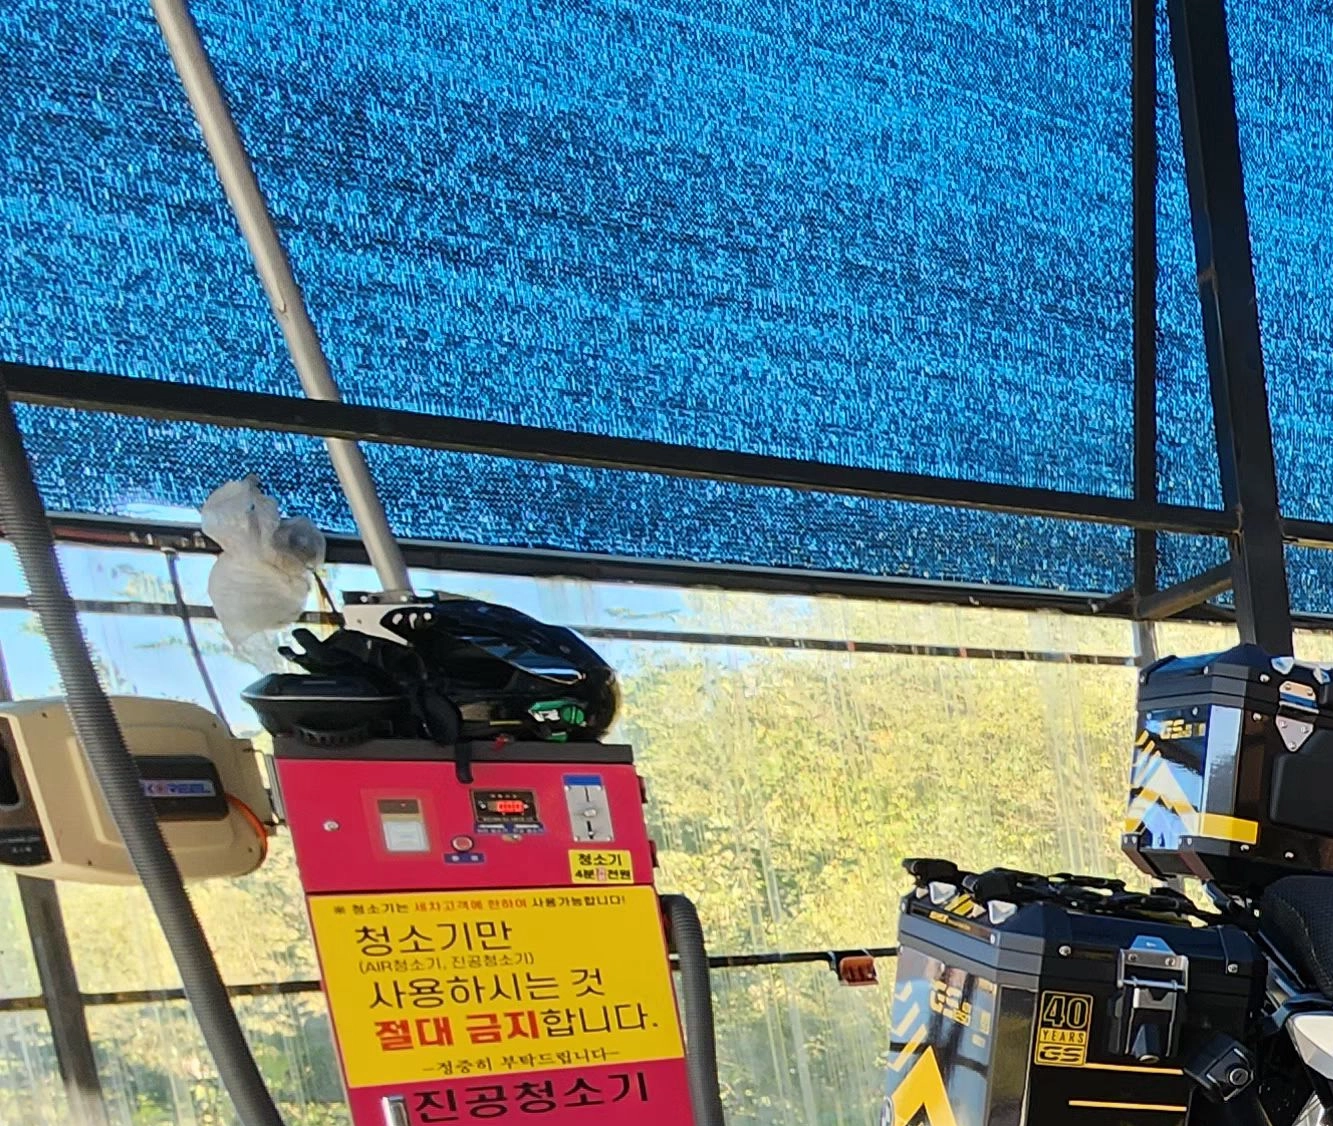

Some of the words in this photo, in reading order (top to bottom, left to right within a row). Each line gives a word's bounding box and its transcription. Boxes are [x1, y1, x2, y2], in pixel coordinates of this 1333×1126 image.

[578, 854, 622, 866] 청소기
[352, 903, 409, 914] 청소기는
[488, 899, 527, 909] 한하여
[531, 895, 626, 908] 사용가능합니다!
[355, 920, 512, 957] 청소기만
[359, 957, 447, 974] (AIR청소기,
[451, 952, 534, 971] 진공청소기)
[369, 972, 559, 1010] 사용하시는
[571, 968, 605, 998] 것
[1043, 996, 1089, 1029] 40
[375, 1016, 454, 1051] 절대
[466, 1002, 659, 1045] 금지합니다.
[1042, 1031, 1085, 1044] YEARS
[1040, 1047, 1081, 1063] GS
[413, 1071, 649, 1124] 진공청소기
